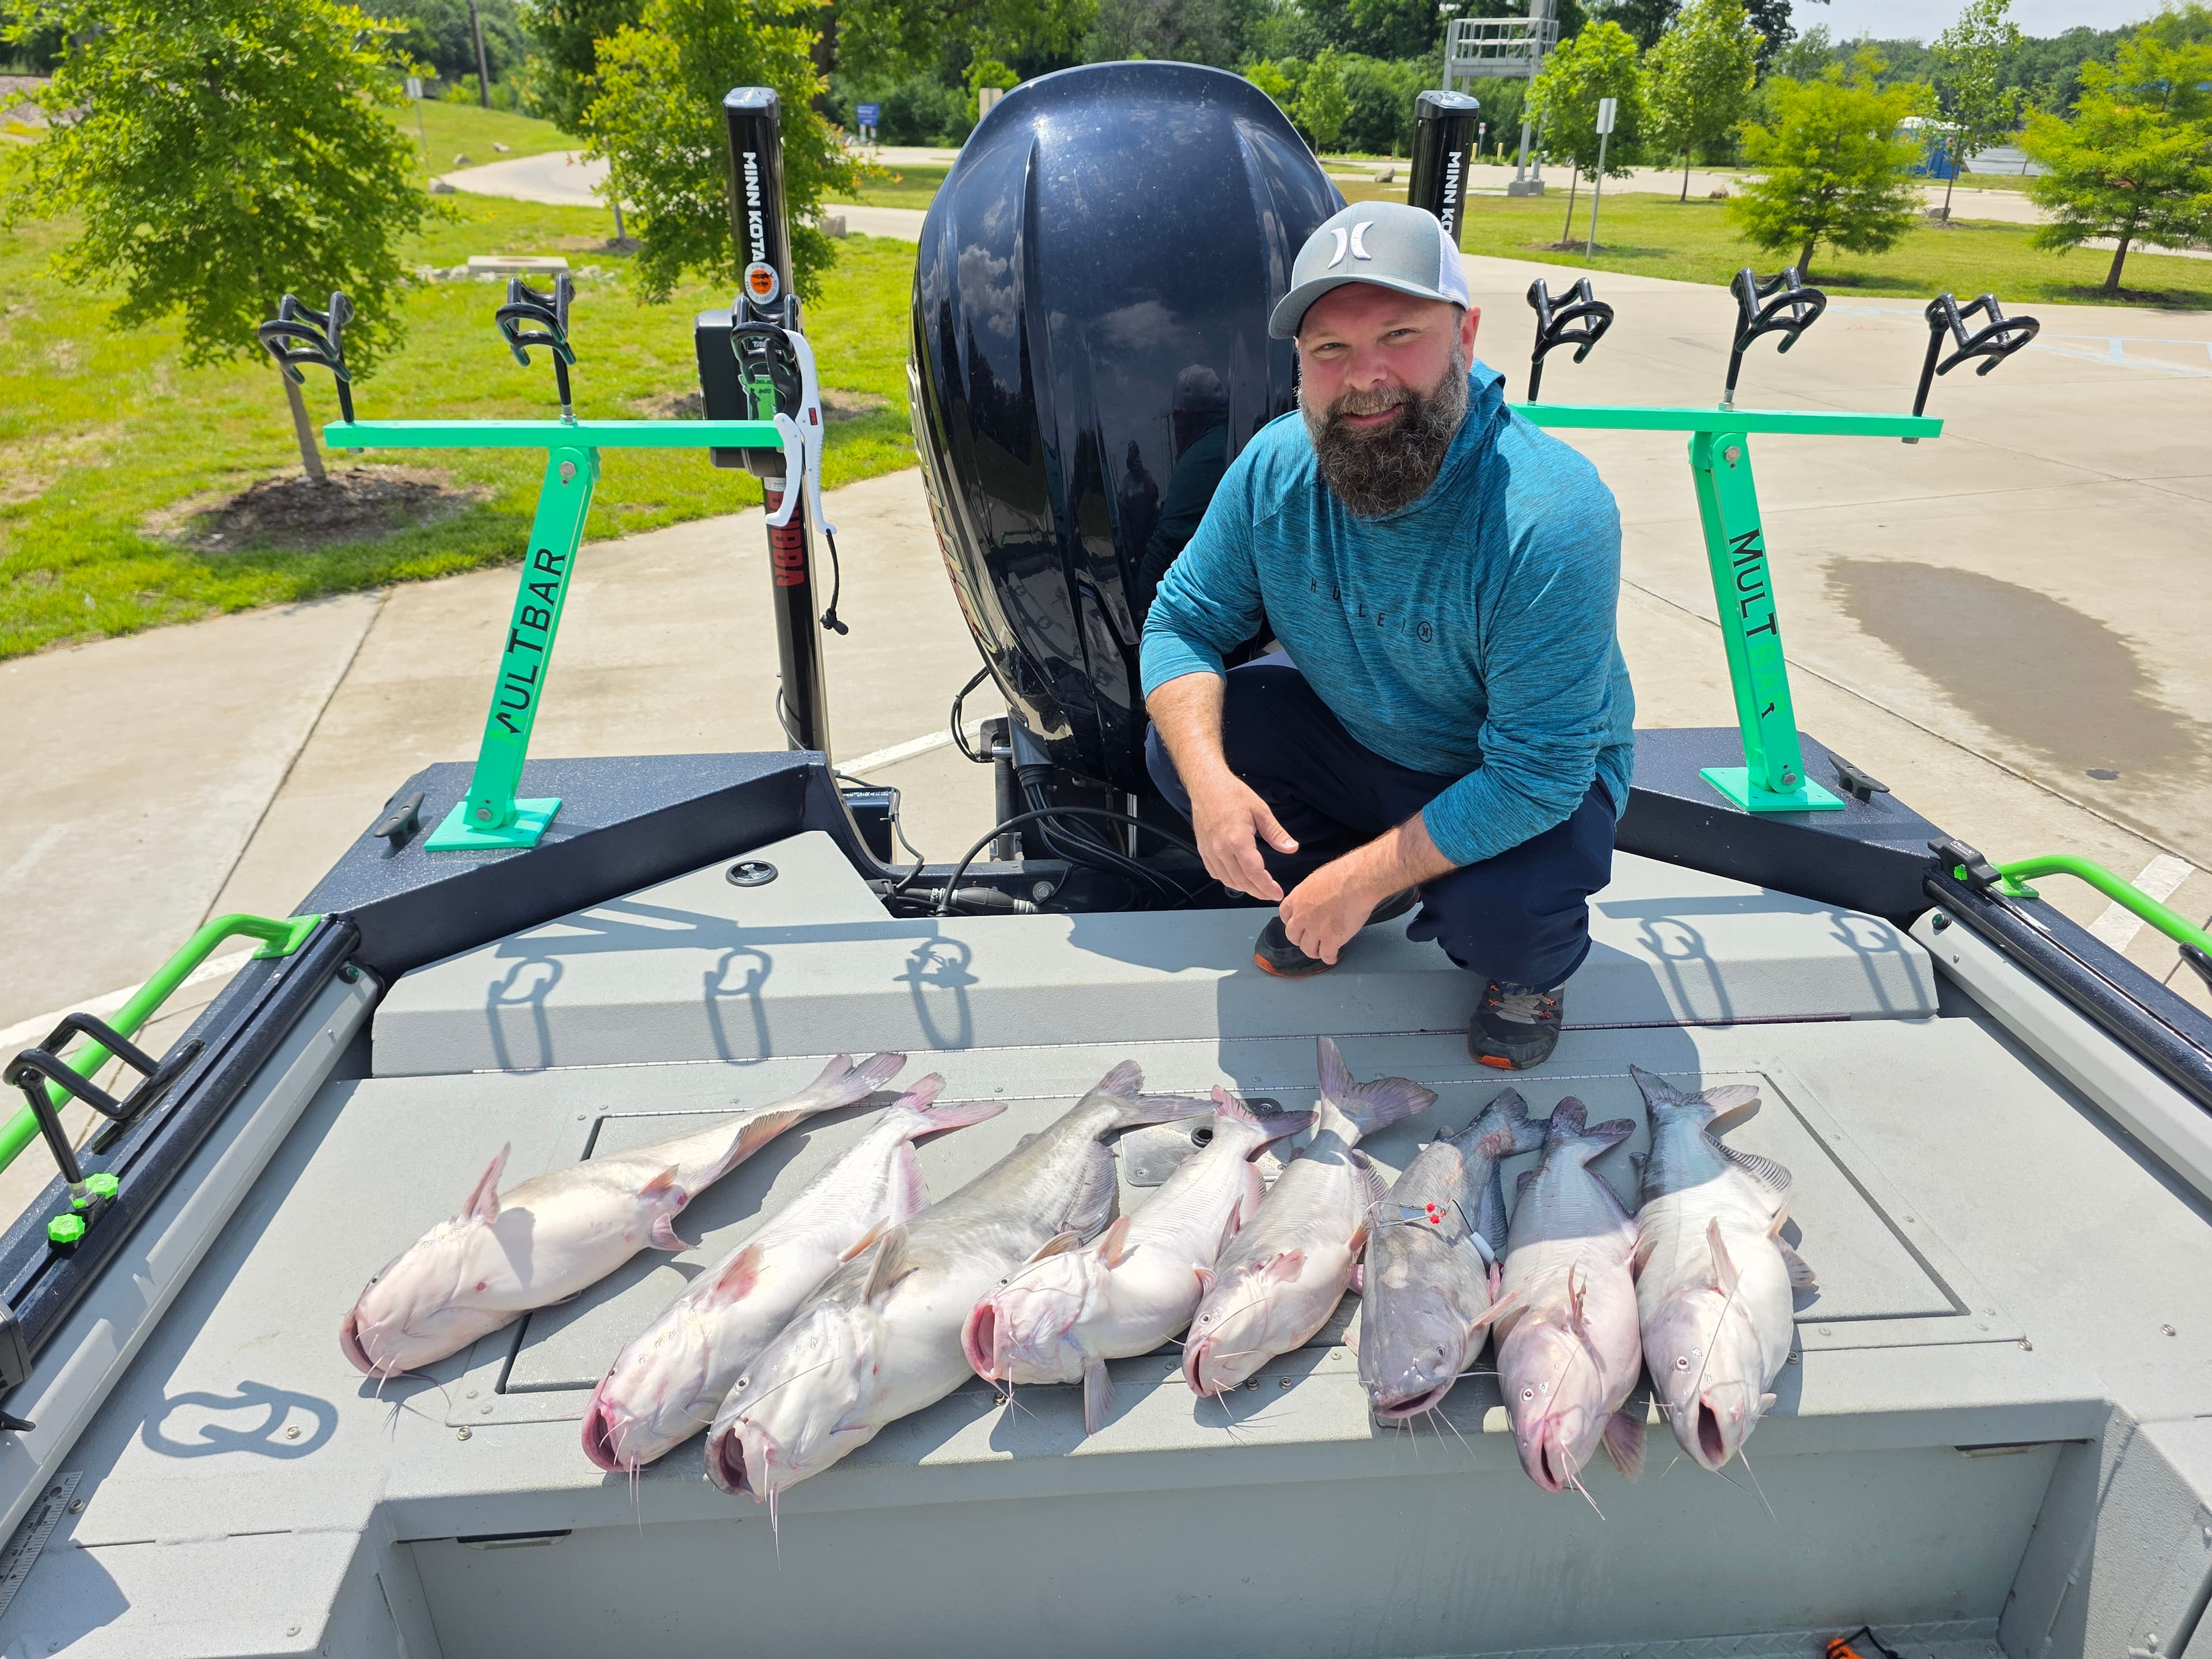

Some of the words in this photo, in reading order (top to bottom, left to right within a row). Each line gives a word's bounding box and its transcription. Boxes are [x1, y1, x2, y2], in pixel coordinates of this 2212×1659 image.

[743, 152, 760, 206] MINN
[1443, 151, 1462, 203] MINN
[748, 211, 765, 262] KOTA
